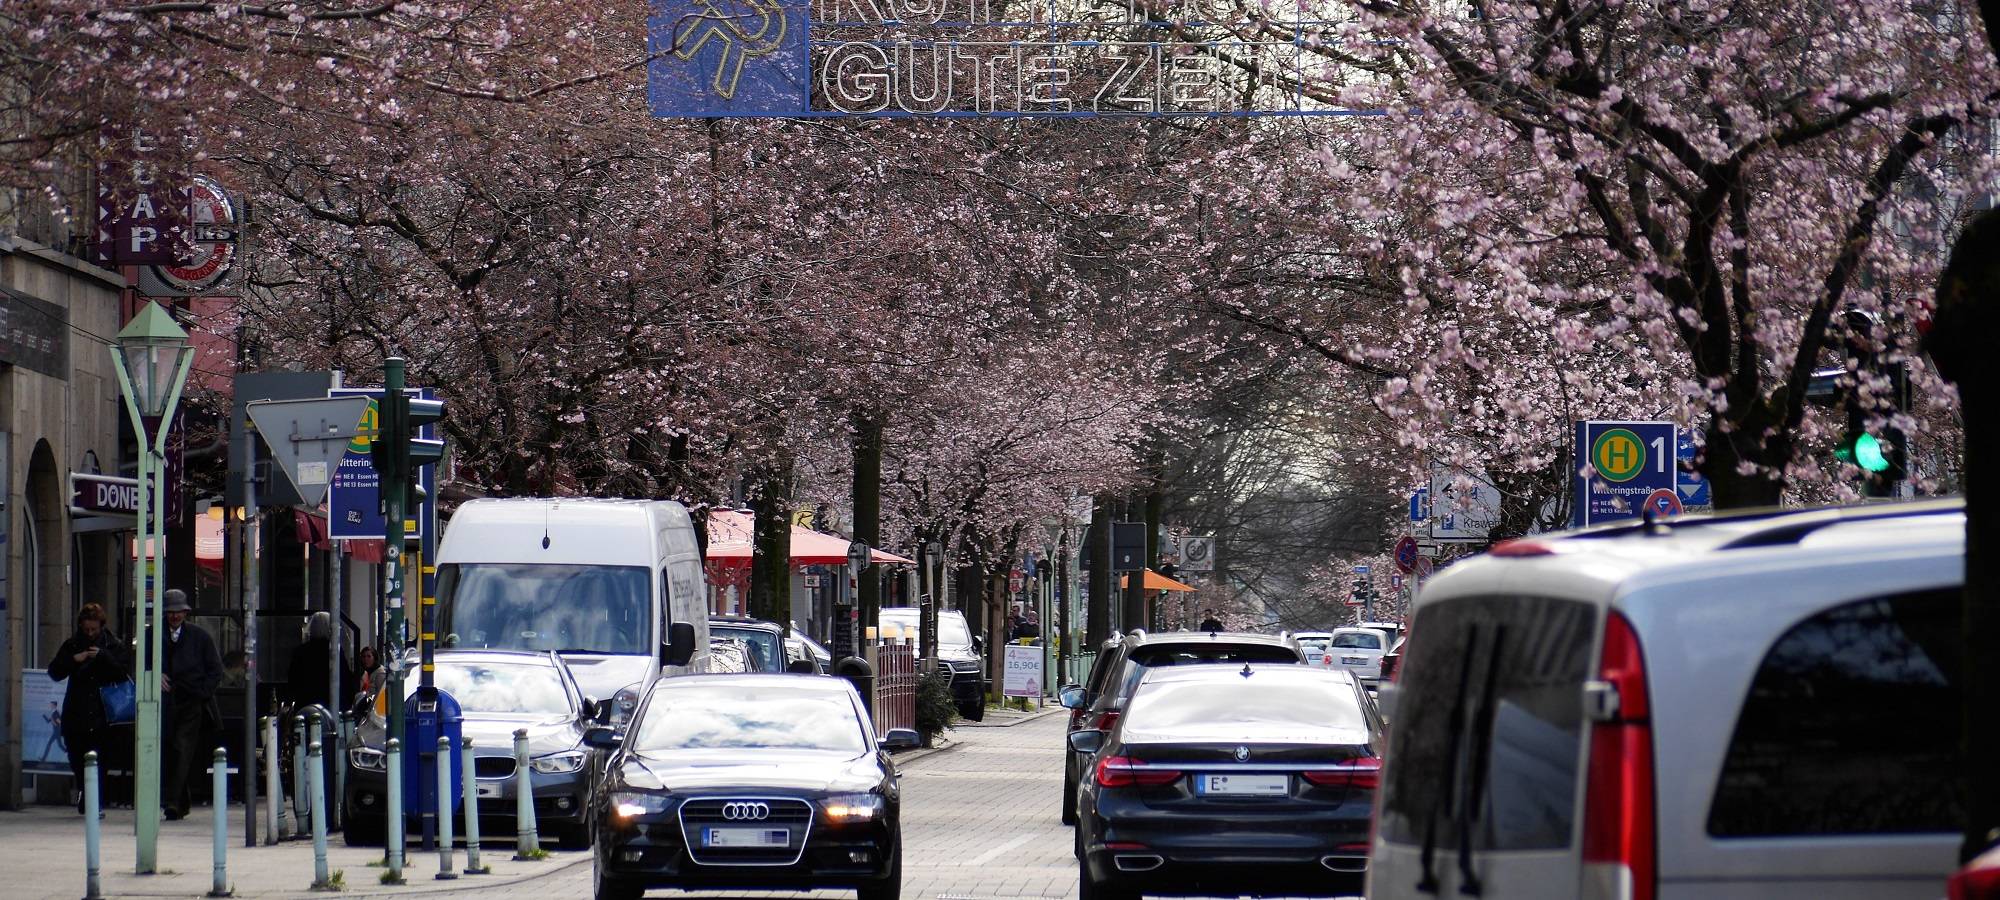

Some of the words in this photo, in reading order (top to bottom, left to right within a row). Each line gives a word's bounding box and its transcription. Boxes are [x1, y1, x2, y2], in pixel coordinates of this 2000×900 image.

[822, 41, 1072, 114] GUTE
[1608, 440, 1630, 470] H
[1650, 436, 1665, 473] 1
[1009, 650, 1016, 659] 4
[1008, 661, 1039, 670] 16,90€
[1211, 777, 1220, 791] E
[712, 831, 720, 844] E
